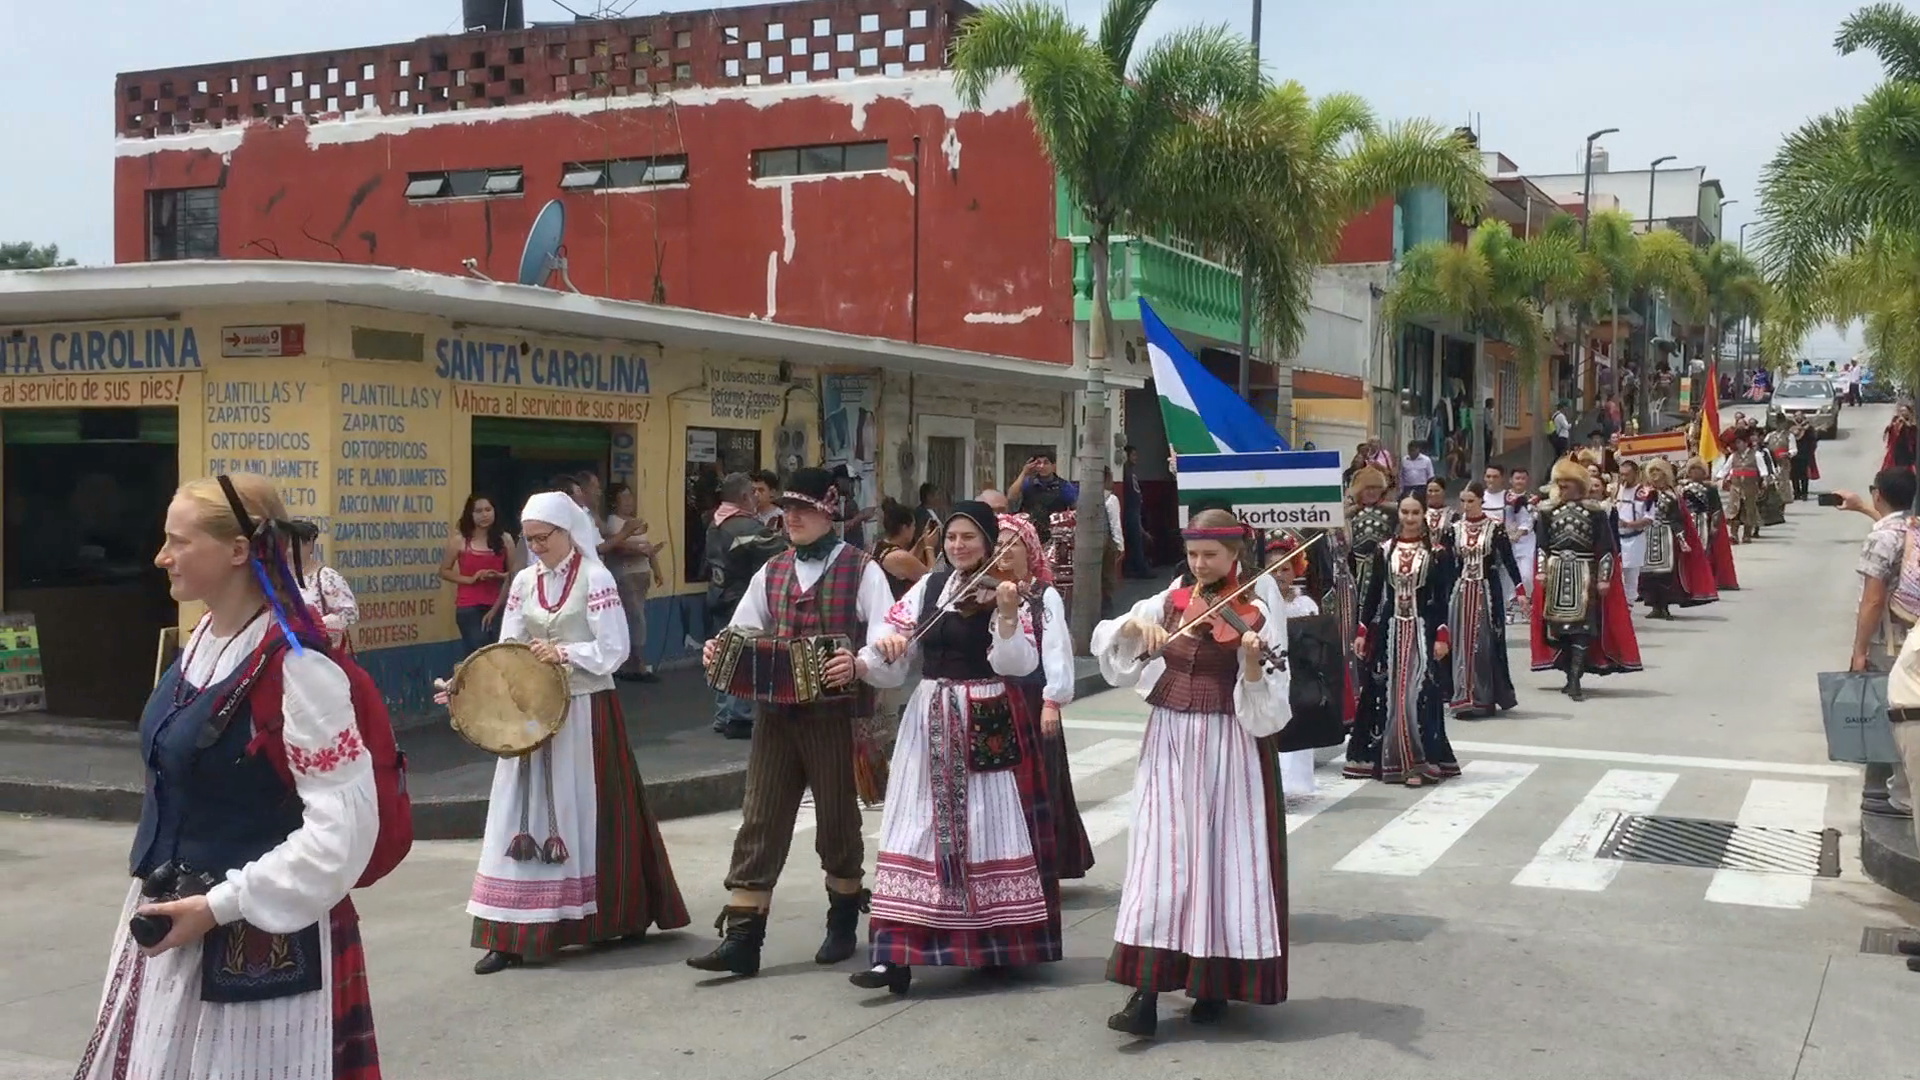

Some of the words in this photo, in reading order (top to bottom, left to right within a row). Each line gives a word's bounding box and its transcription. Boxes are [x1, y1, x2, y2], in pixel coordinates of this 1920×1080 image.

[270, 330, 280, 344] 9
[51, 327, 201, 371] CAROLINA
[435, 338, 521, 385] SANTA
[531, 348, 650, 394] CAROLINA
[3, 379, 15, 404] al
[20, 377, 77, 402] servicio
[81, 378, 99, 401] de
[104, 380, 131, 401] sus
[141, 374, 184, 405] pies!
[207, 381, 291, 404] PLANTILLAS
[295, 382, 306, 403] Y
[341, 382, 429, 409] PLANTILLAS
[431, 388, 442, 409] Y
[208, 405, 271, 424] ZAPATOS
[505, 391, 517, 415] al
[522, 394, 572, 417] servicio
[575, 397, 590, 417] de
[593, 400, 613, 417] sus
[618, 400, 650, 422] pies!
[711, 402, 733, 418] Dolor
[734, 405, 744, 420] de
[342, 412, 405, 433] ZAPATOS
[211, 431, 311, 450] ORTOPEDICOS
[341, 440, 428, 460] ORTOPEDICOS
[210, 459, 226, 477] PIE
[337, 467, 354, 487] PIE
[360, 467, 396, 487] PLANO
[396, 467, 447, 487] JUANETES
[339, 495, 369, 513] ARCO
[371, 495, 400, 513] MUY
[403, 495, 434, 513] ALTO
[335, 522, 381, 541] ZAPATOS
[336, 549, 393, 570] TALONERAS
[381, 572, 442, 593] ESPECIALES
[420, 599, 435, 616] DE
[358, 624, 419, 645] PROTESIS
